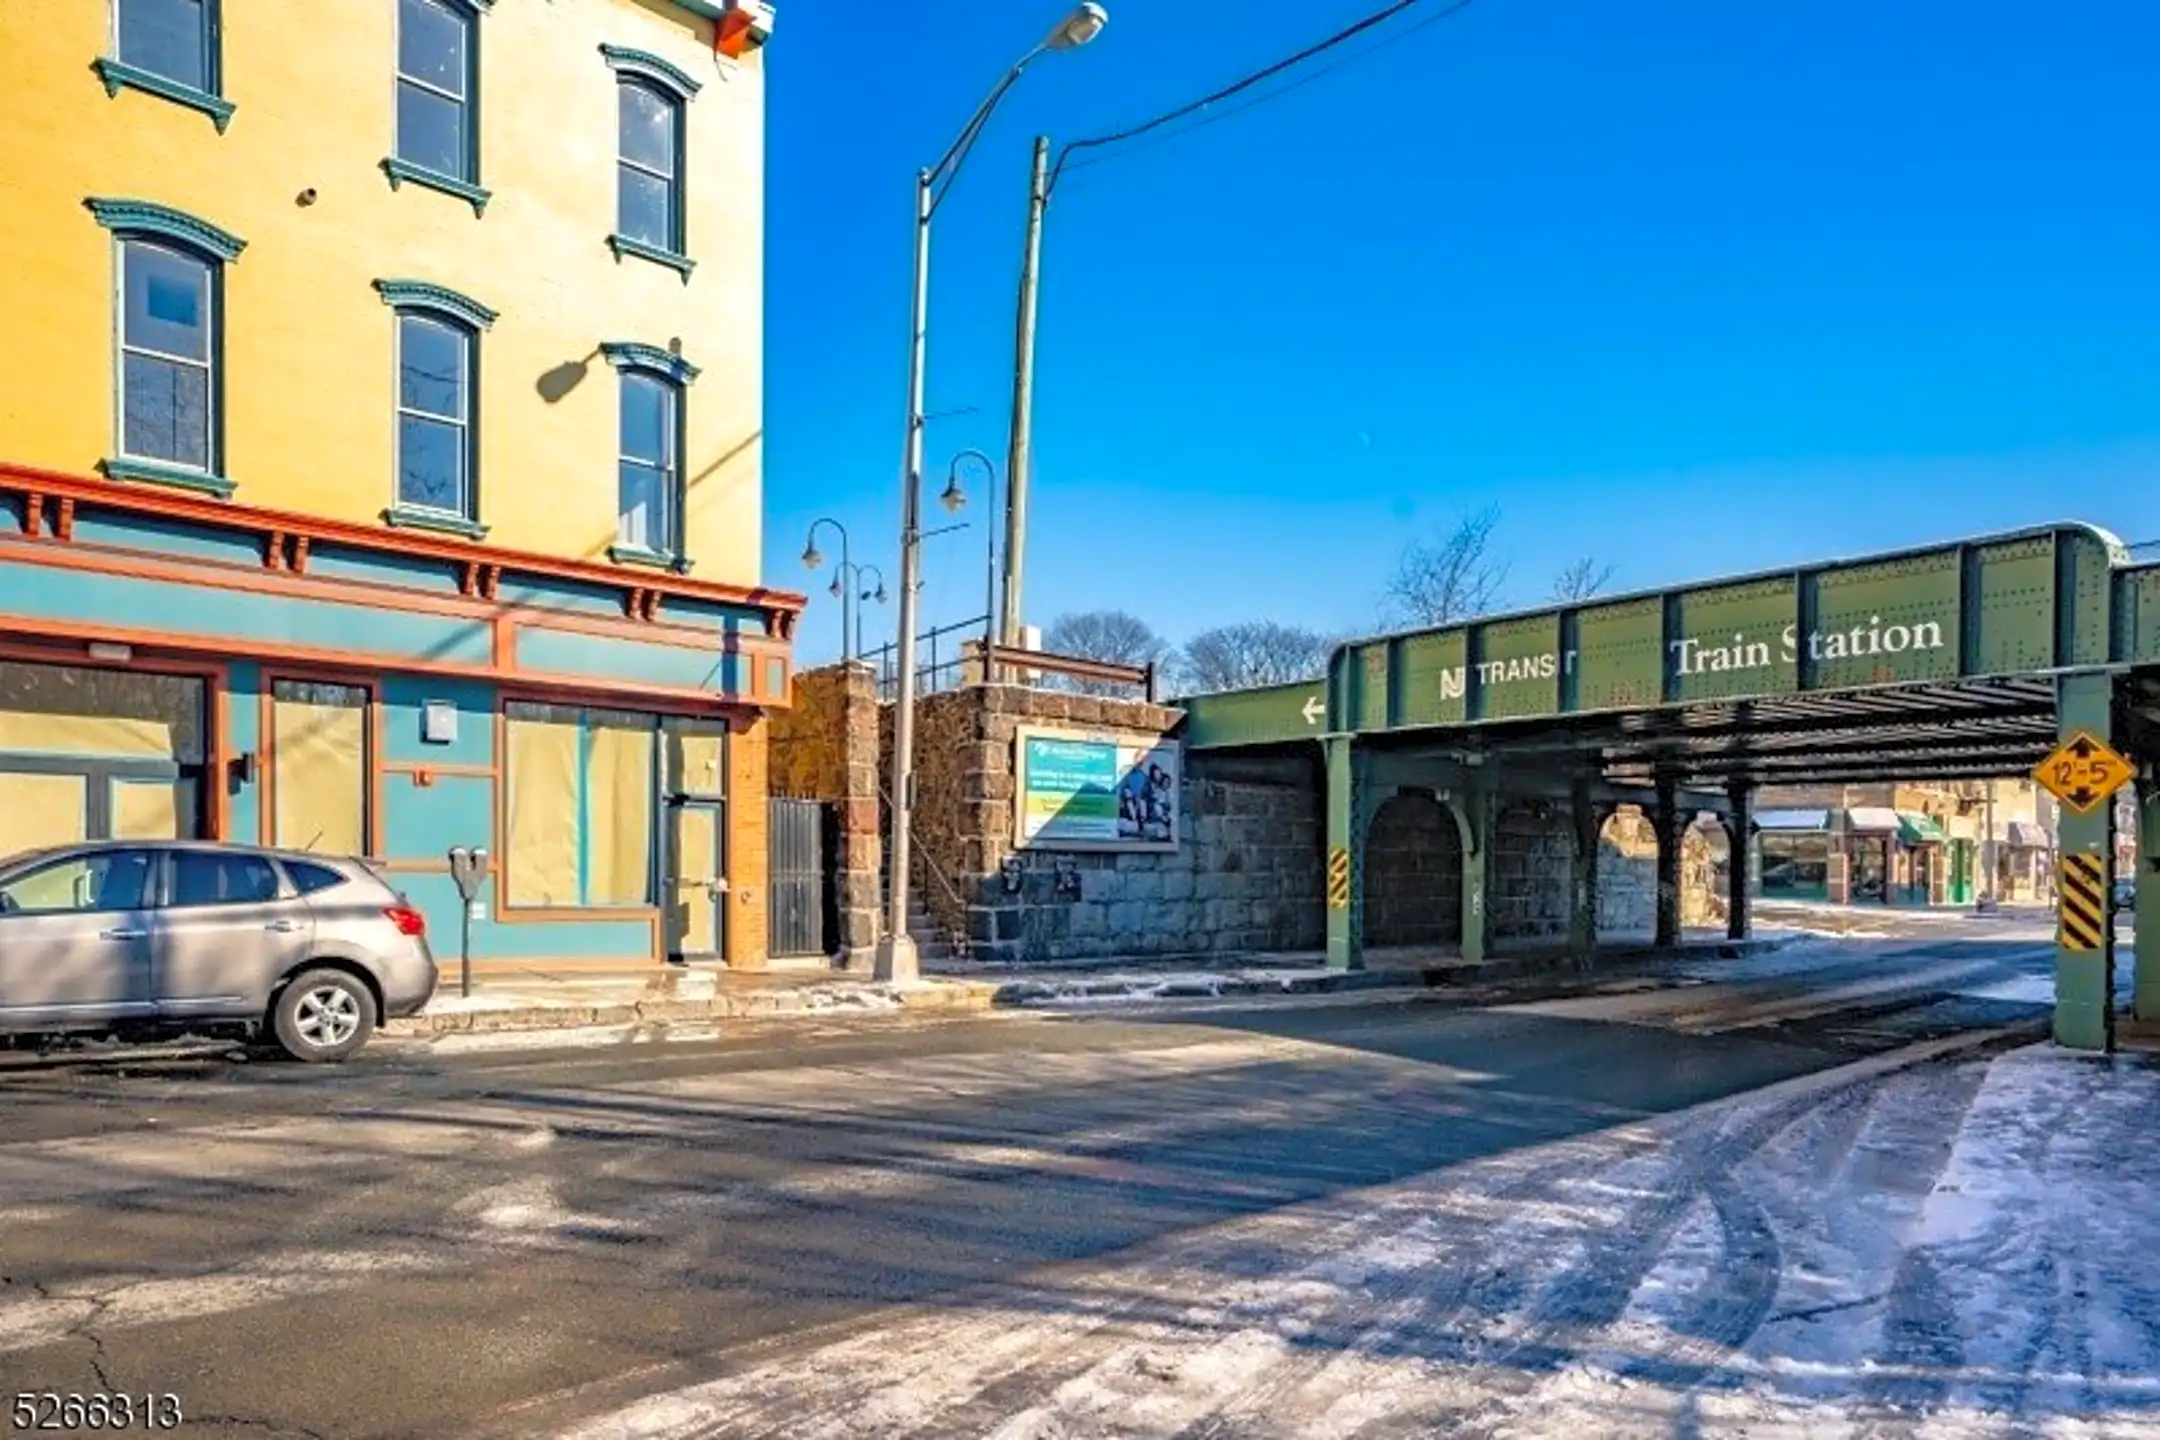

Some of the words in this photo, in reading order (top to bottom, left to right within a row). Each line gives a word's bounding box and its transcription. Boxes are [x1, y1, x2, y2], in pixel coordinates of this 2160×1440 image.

[1475, 650, 1578, 686] TRANST
[1670, 632, 1772, 677] Train
[1780, 615, 1945, 663] Station
